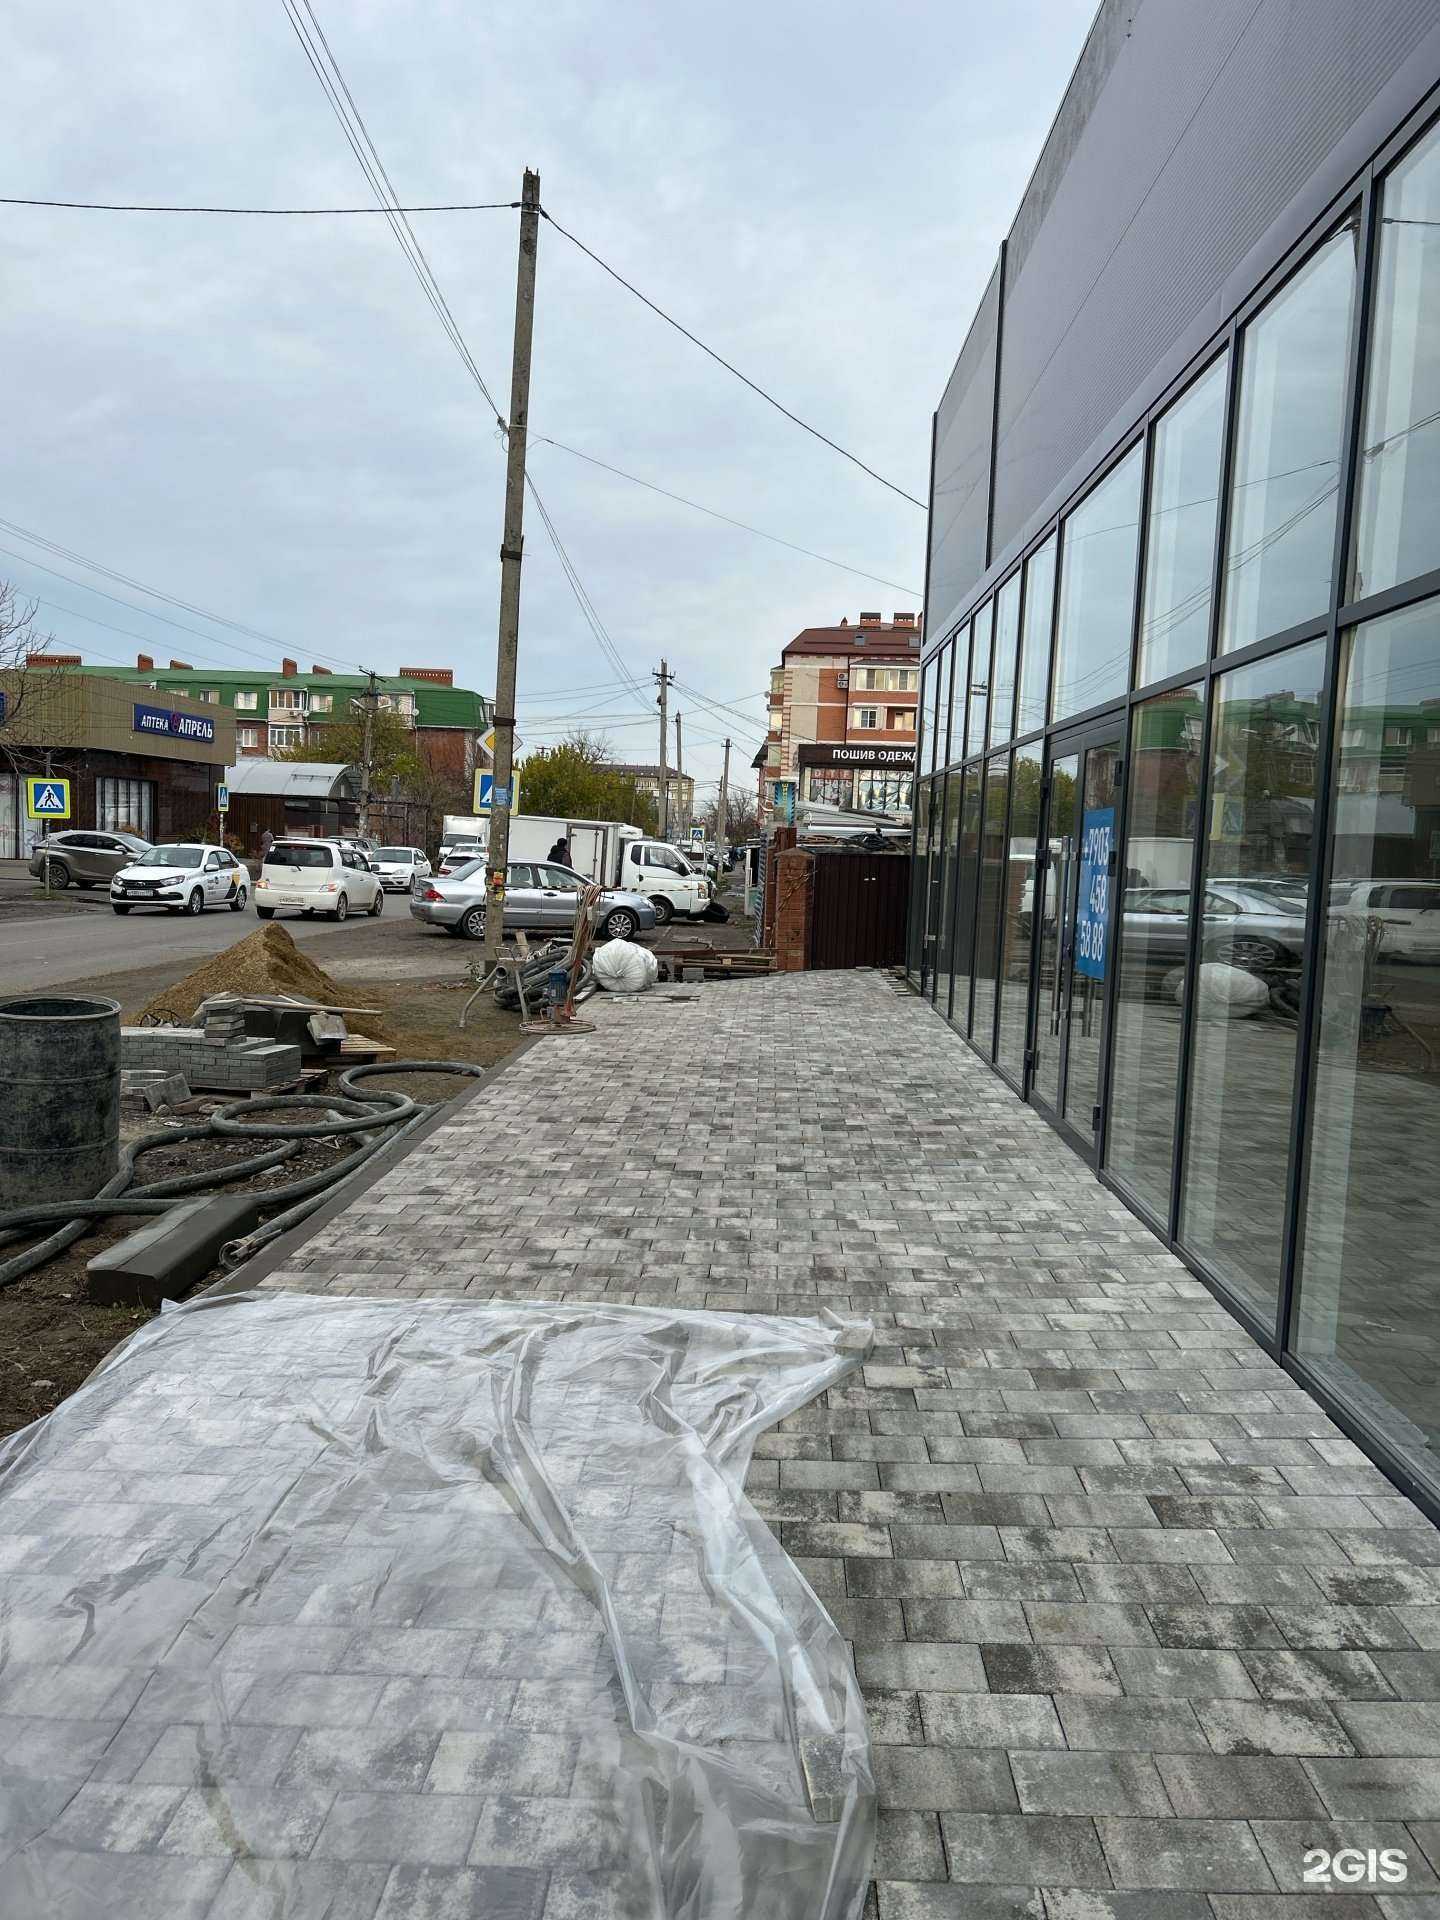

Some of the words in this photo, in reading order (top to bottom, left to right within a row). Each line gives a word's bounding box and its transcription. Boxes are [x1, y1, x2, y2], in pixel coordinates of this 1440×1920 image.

[141, 715, 168, 731] АПТЕКА
[178, 718, 213, 738] АПРЕЛЬ
[832, 749, 876, 760] ПОШИВ
[1089, 875, 1107, 914] 458
